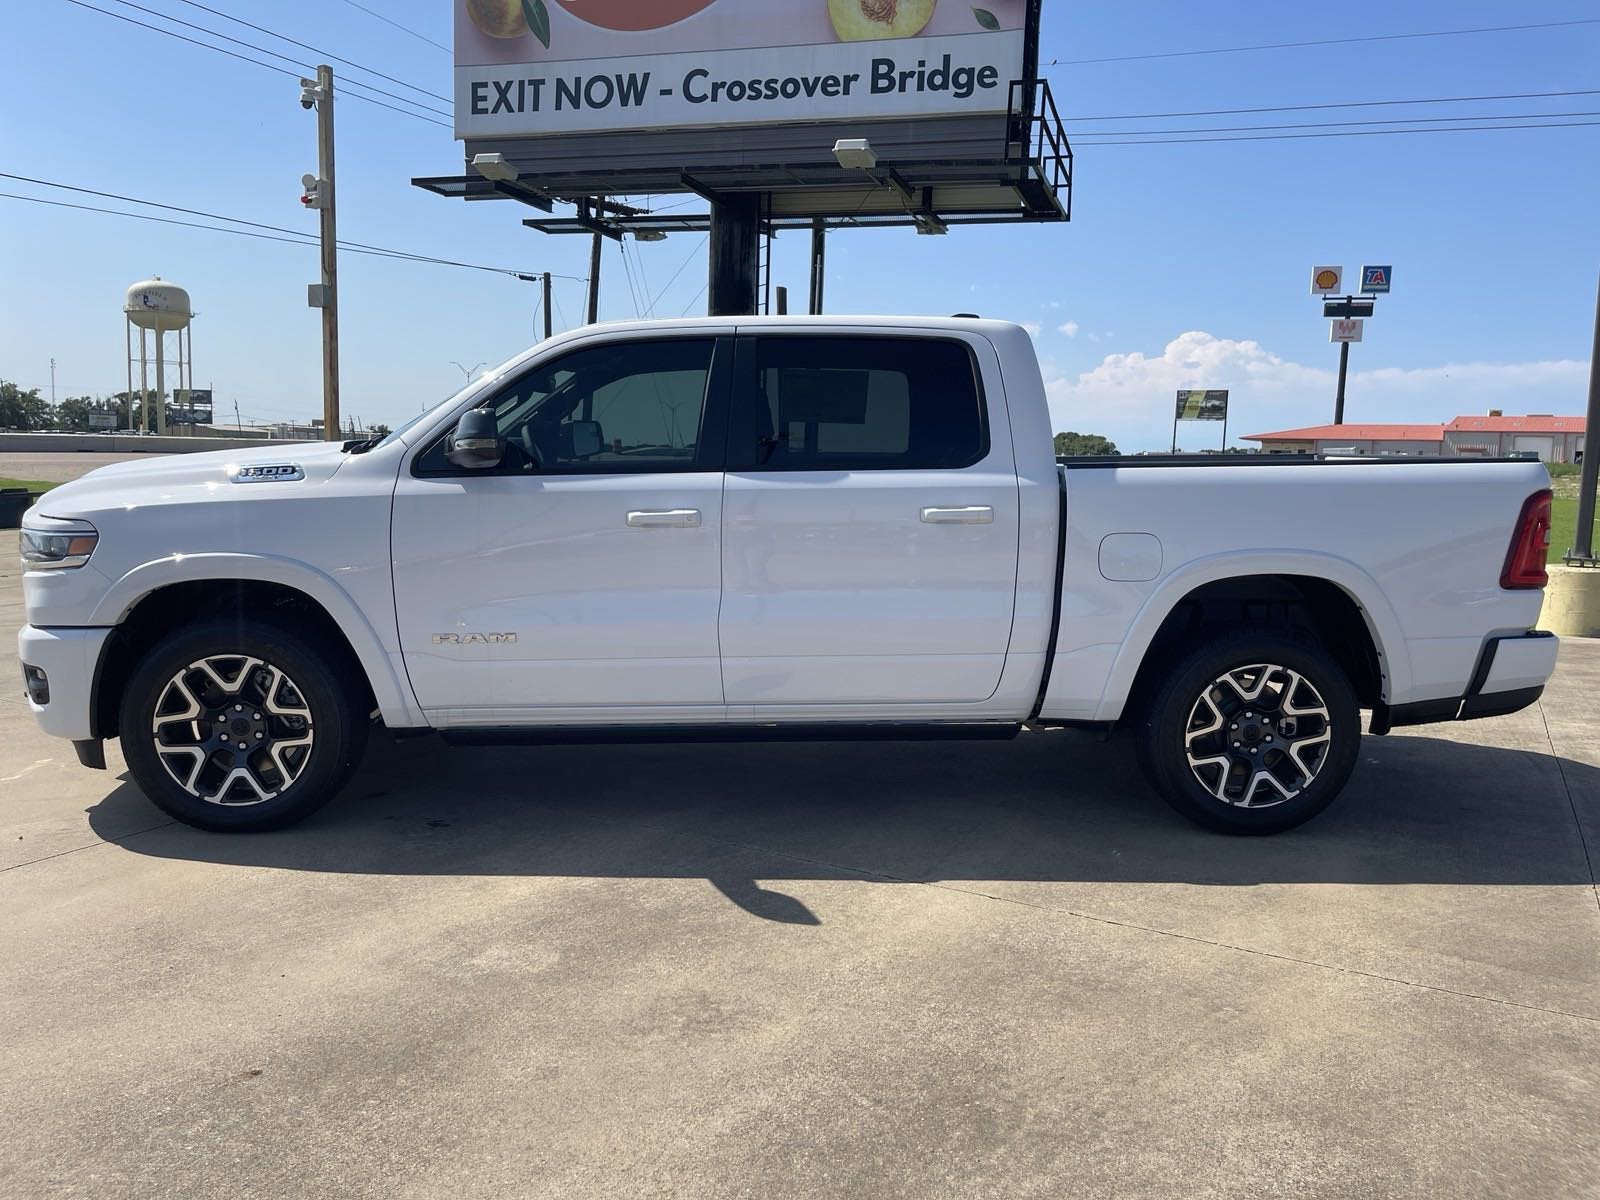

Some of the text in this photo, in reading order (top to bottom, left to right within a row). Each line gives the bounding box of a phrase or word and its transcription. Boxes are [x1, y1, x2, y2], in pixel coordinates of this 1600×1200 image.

[471, 79, 546, 115] EXIT
[555, 72, 650, 111] NOW
[682, 68, 860, 103] Crossover
[869, 54, 999, 98] Bridge
[1367, 268, 1386, 284] TA
[431, 632, 518, 645] RAM
